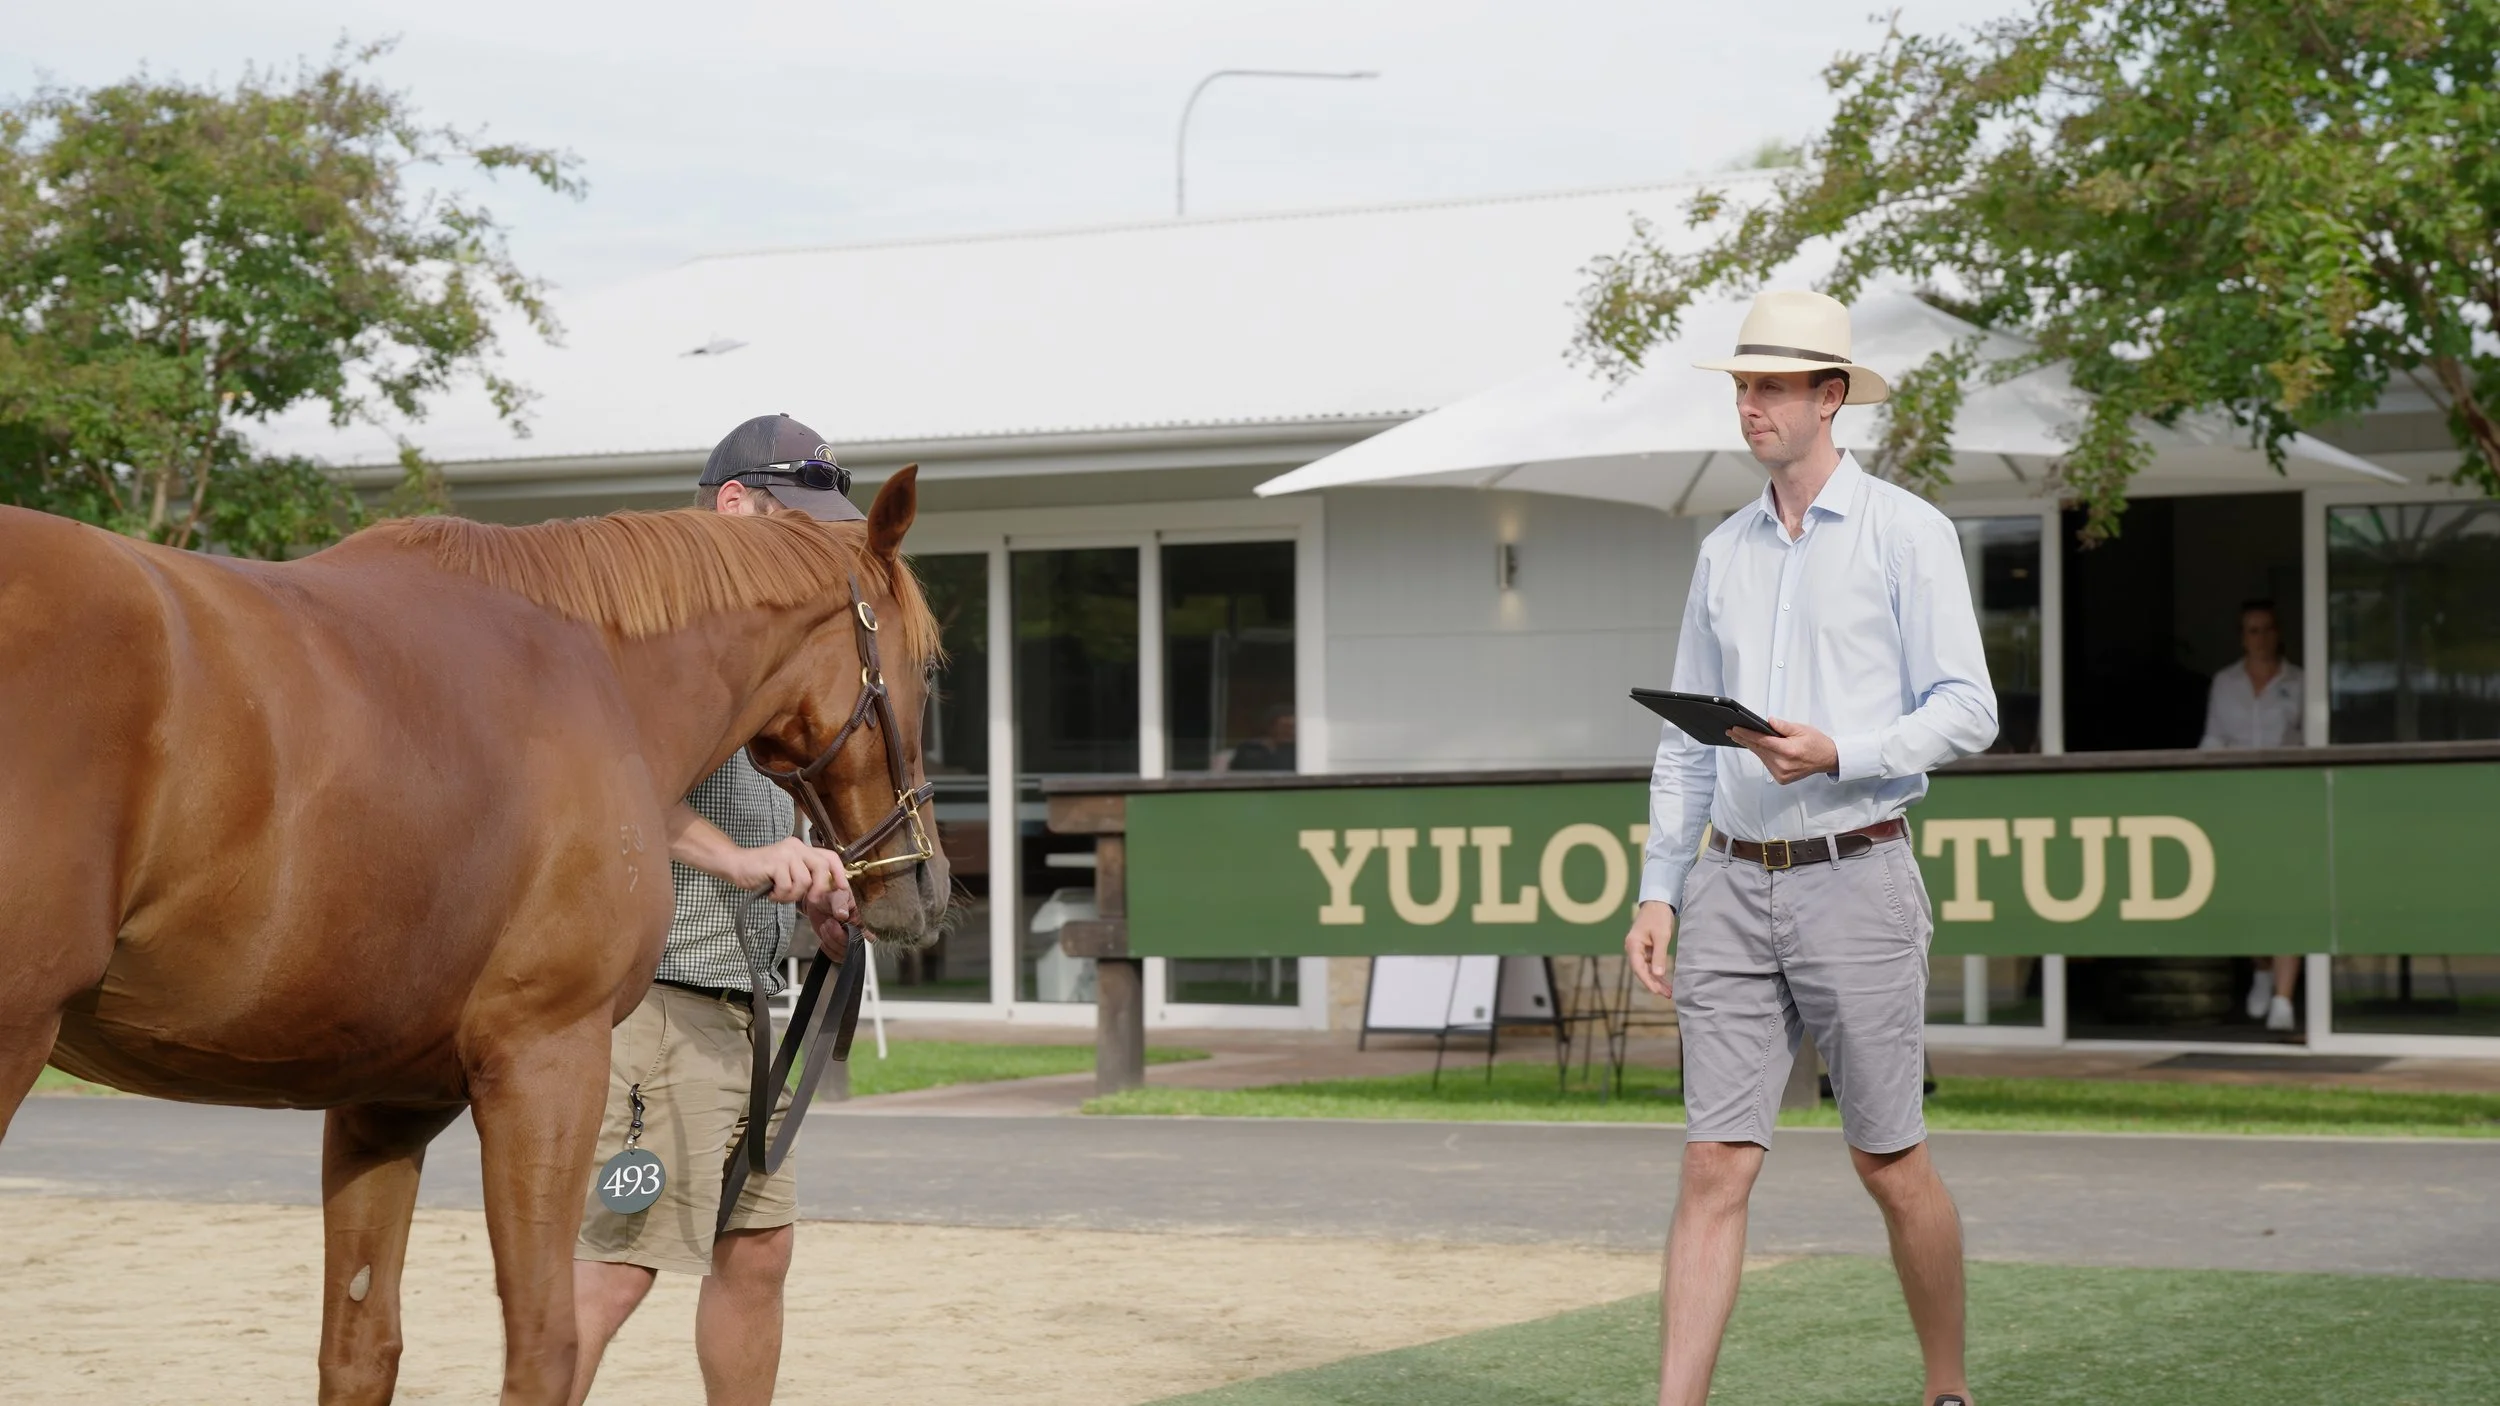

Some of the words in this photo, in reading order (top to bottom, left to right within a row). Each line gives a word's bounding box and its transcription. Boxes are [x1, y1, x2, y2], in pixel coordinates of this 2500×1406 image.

[1299, 823, 1712, 924] YULO
[1911, 815, 2216, 922] TUD
[603, 1163, 660, 1197] 493
